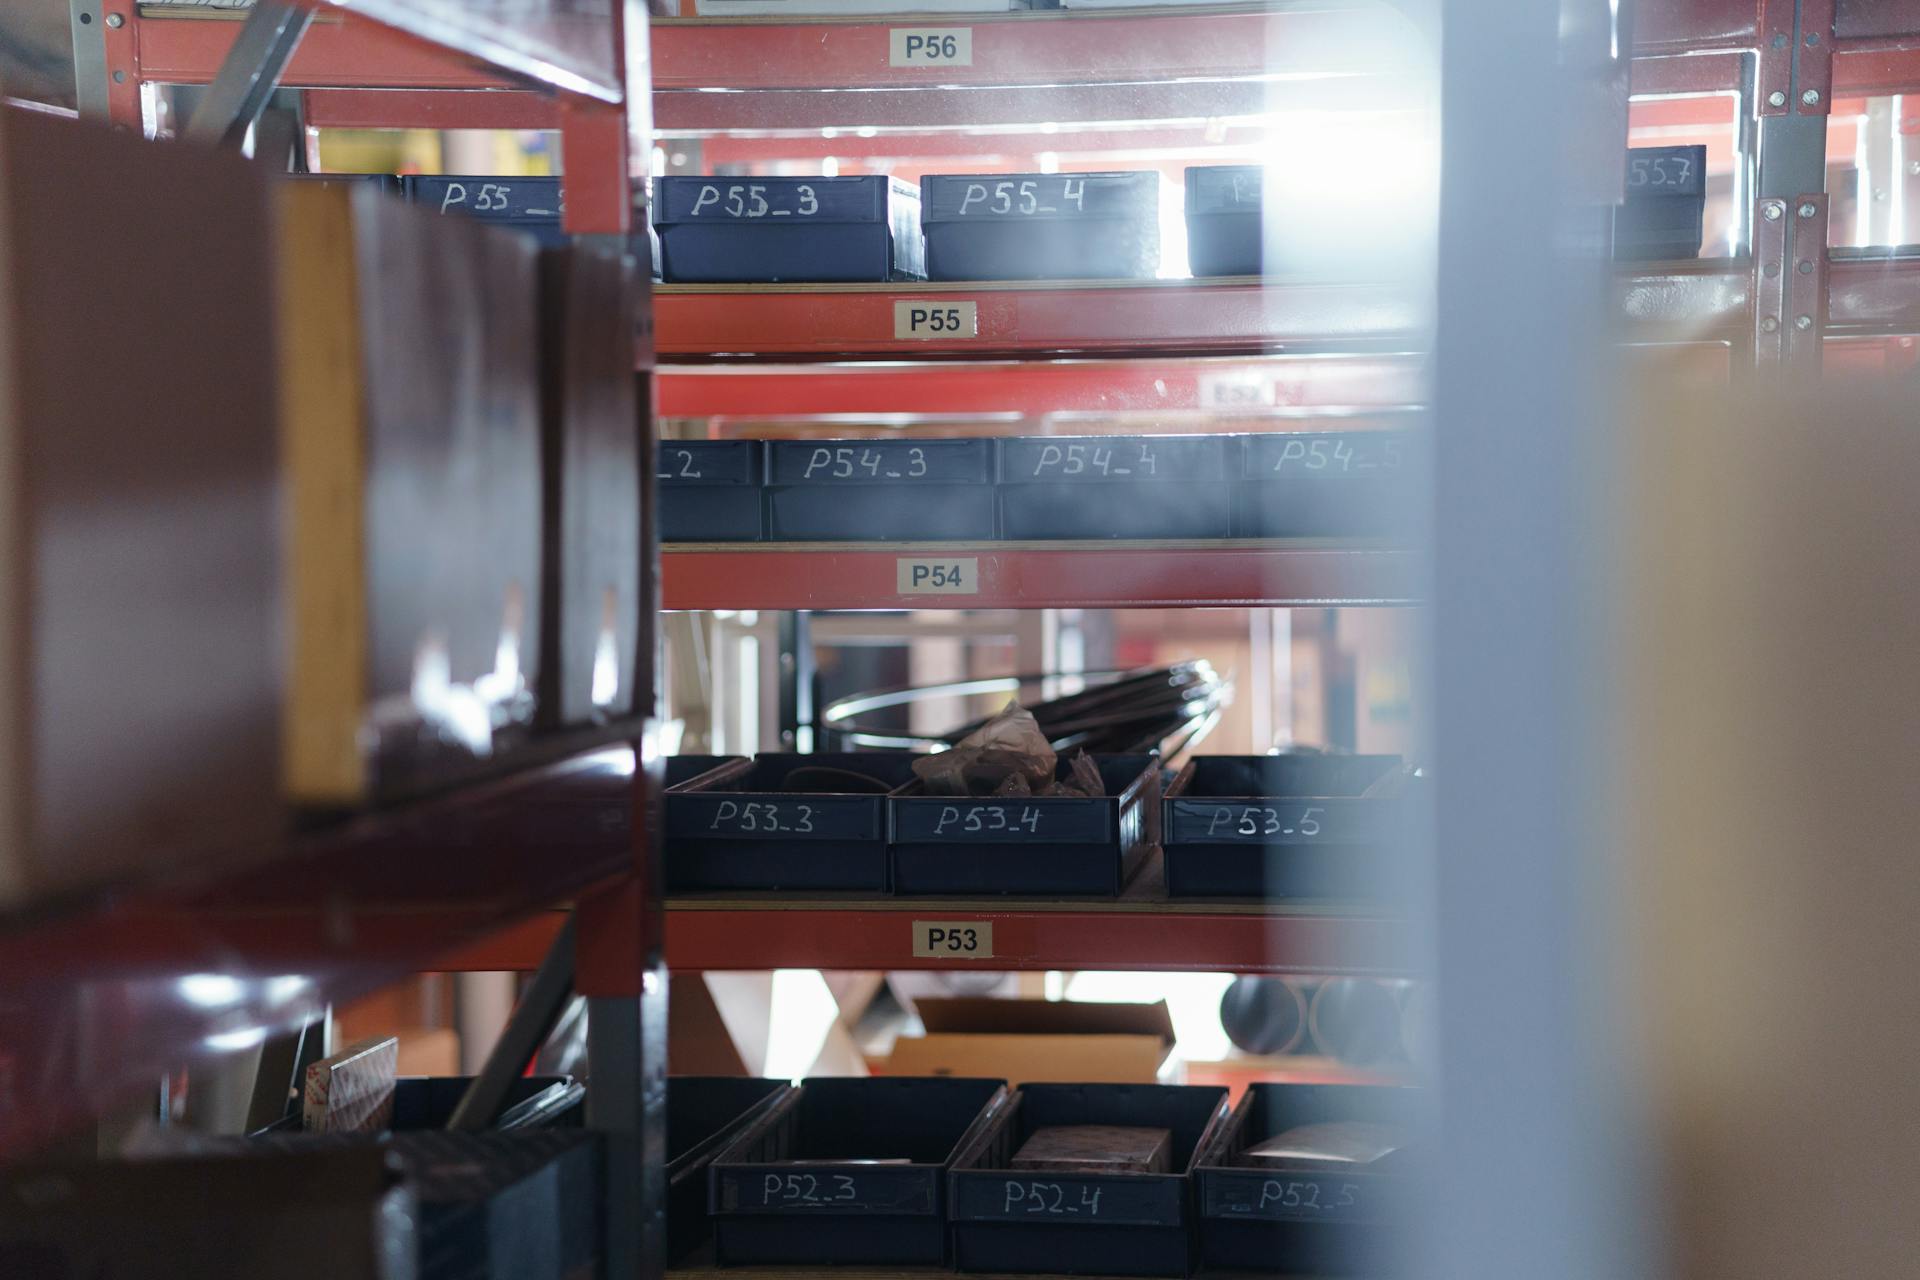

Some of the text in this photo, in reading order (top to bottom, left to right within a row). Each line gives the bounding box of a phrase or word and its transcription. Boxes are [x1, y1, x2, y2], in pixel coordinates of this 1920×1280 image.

[906, 35, 957, 59] P56
[691, 185, 819, 218] P55_3
[958, 179, 1084, 215] P55_4
[910, 309, 961, 332] P55
[804, 448, 927, 478] P54_3
[1033, 444, 1156, 476] P54_4
[912, 565, 962, 588] P54
[711, 801, 813, 833] P53_3
[934, 807, 1039, 835] P53_4
[1208, 808, 1323, 836] P53_5
[928, 928, 978, 952] P53
[764, 1174, 856, 1206] P52_3
[1005, 1181, 1102, 1215] P52_4
[1259, 1180, 1359, 1209] P52_5
